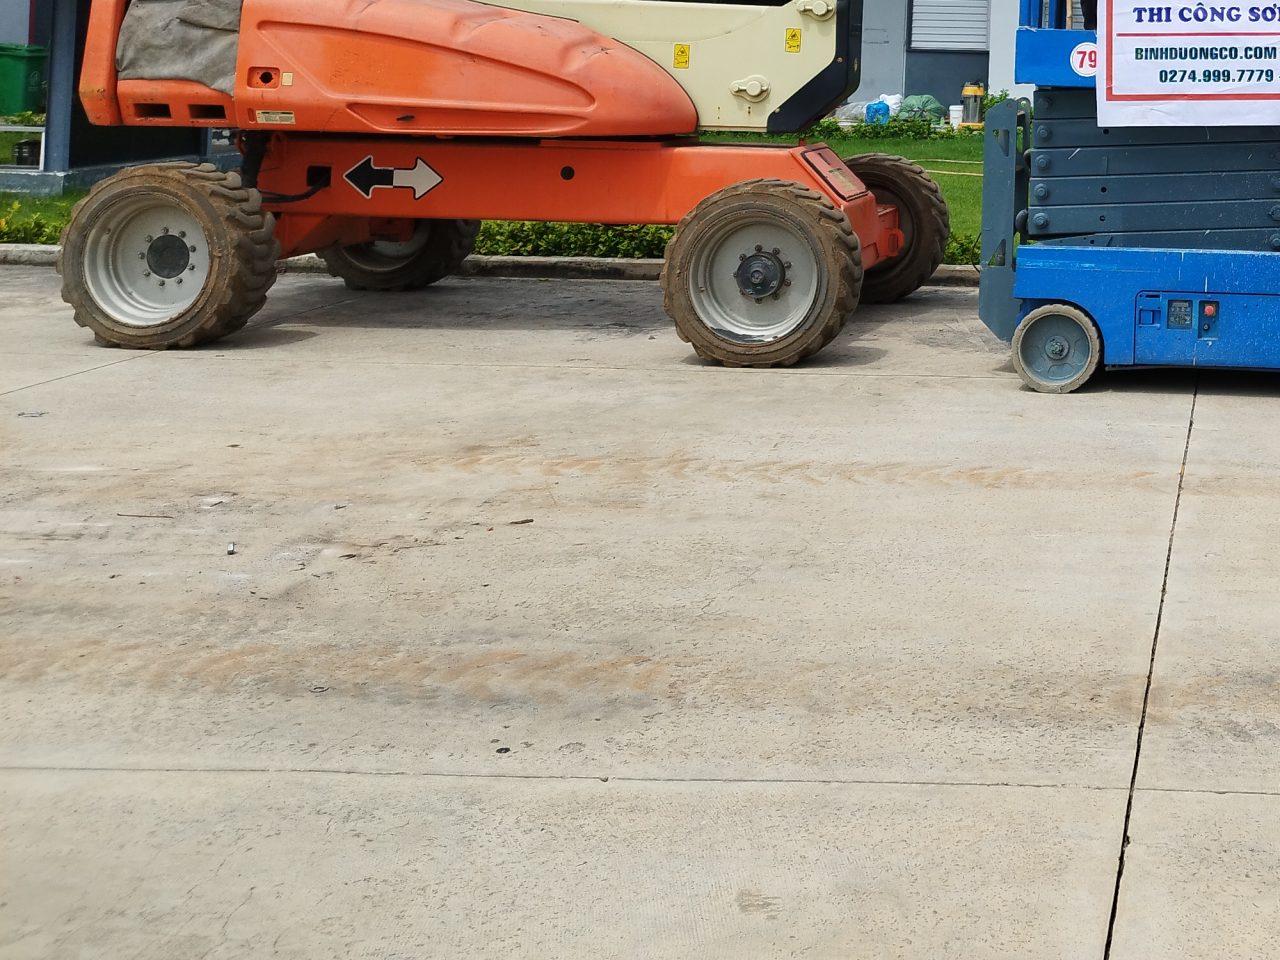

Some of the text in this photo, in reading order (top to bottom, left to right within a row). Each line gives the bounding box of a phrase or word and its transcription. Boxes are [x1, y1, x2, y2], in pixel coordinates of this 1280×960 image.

[1133, 6, 1172, 23] THI
[1178, 2, 1242, 23] CÔNG
[1134, 46, 1277, 60] BINHDUONGCO.COM
[1159, 69, 1274, 83] 0274.999.7779
